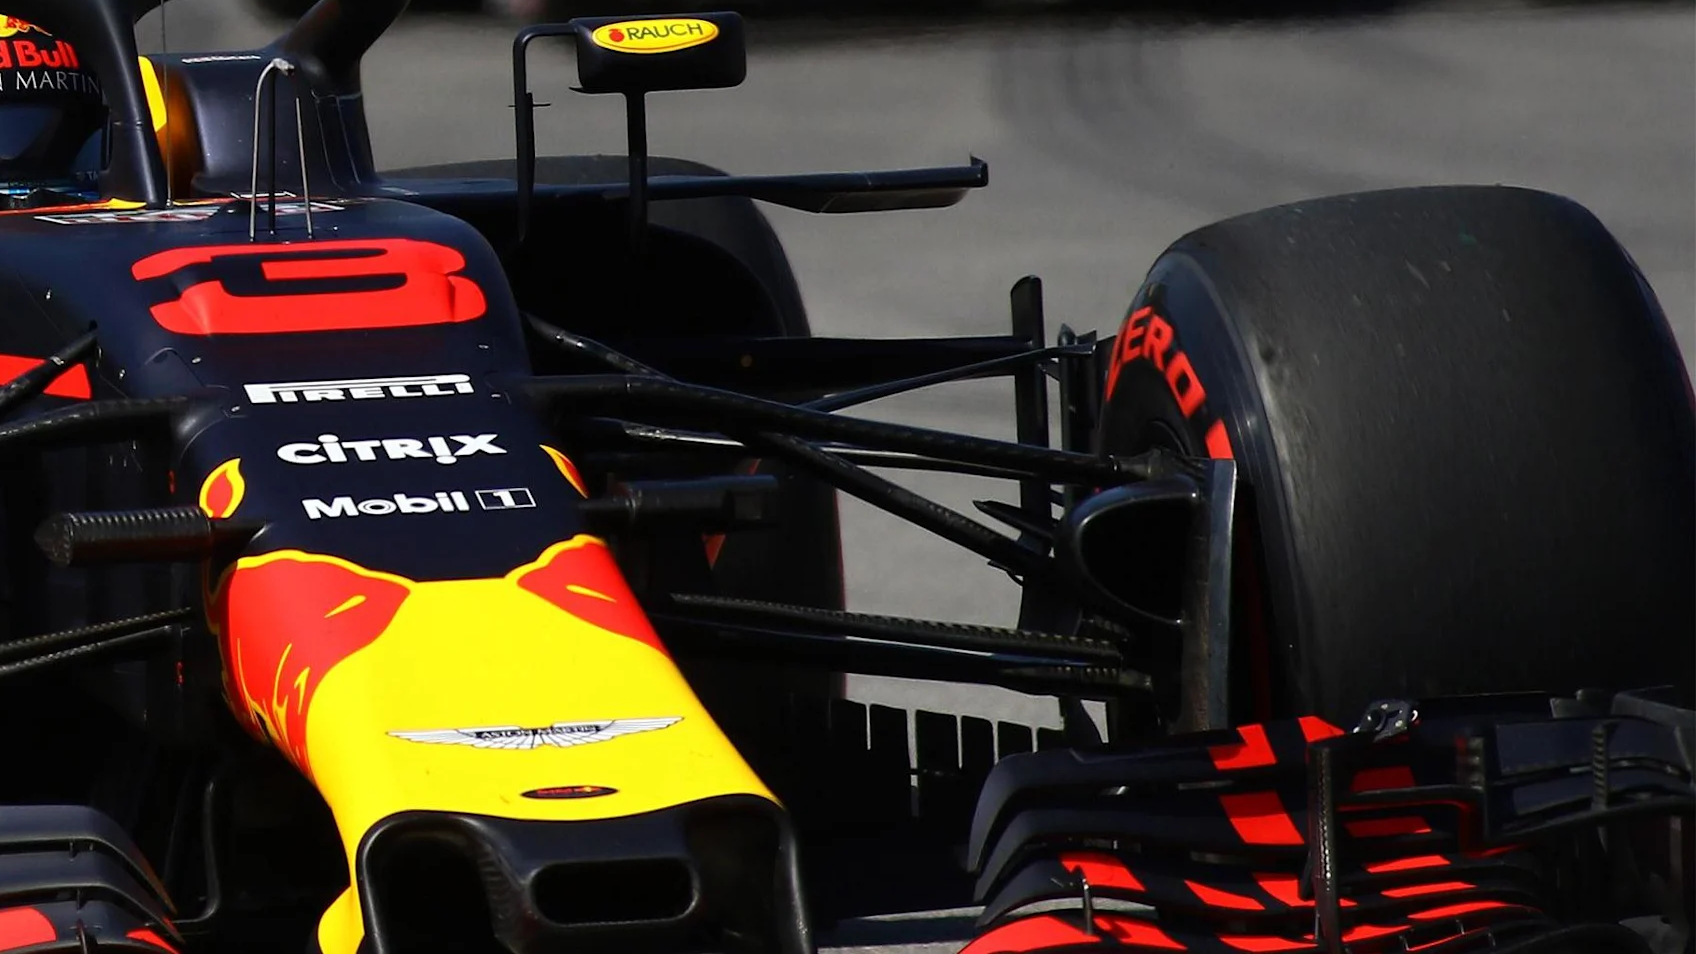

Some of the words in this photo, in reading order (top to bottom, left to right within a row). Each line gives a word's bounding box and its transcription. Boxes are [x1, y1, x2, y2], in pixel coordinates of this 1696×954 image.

[626, 23, 704, 41] RAUCH
[12, 39, 80, 70] Bull
[16, 71, 101, 96] MARTIN
[131, 238, 487, 335] 3
[244, 374, 475, 404] PIRELLI
[302, 491, 470, 520] Mobil
